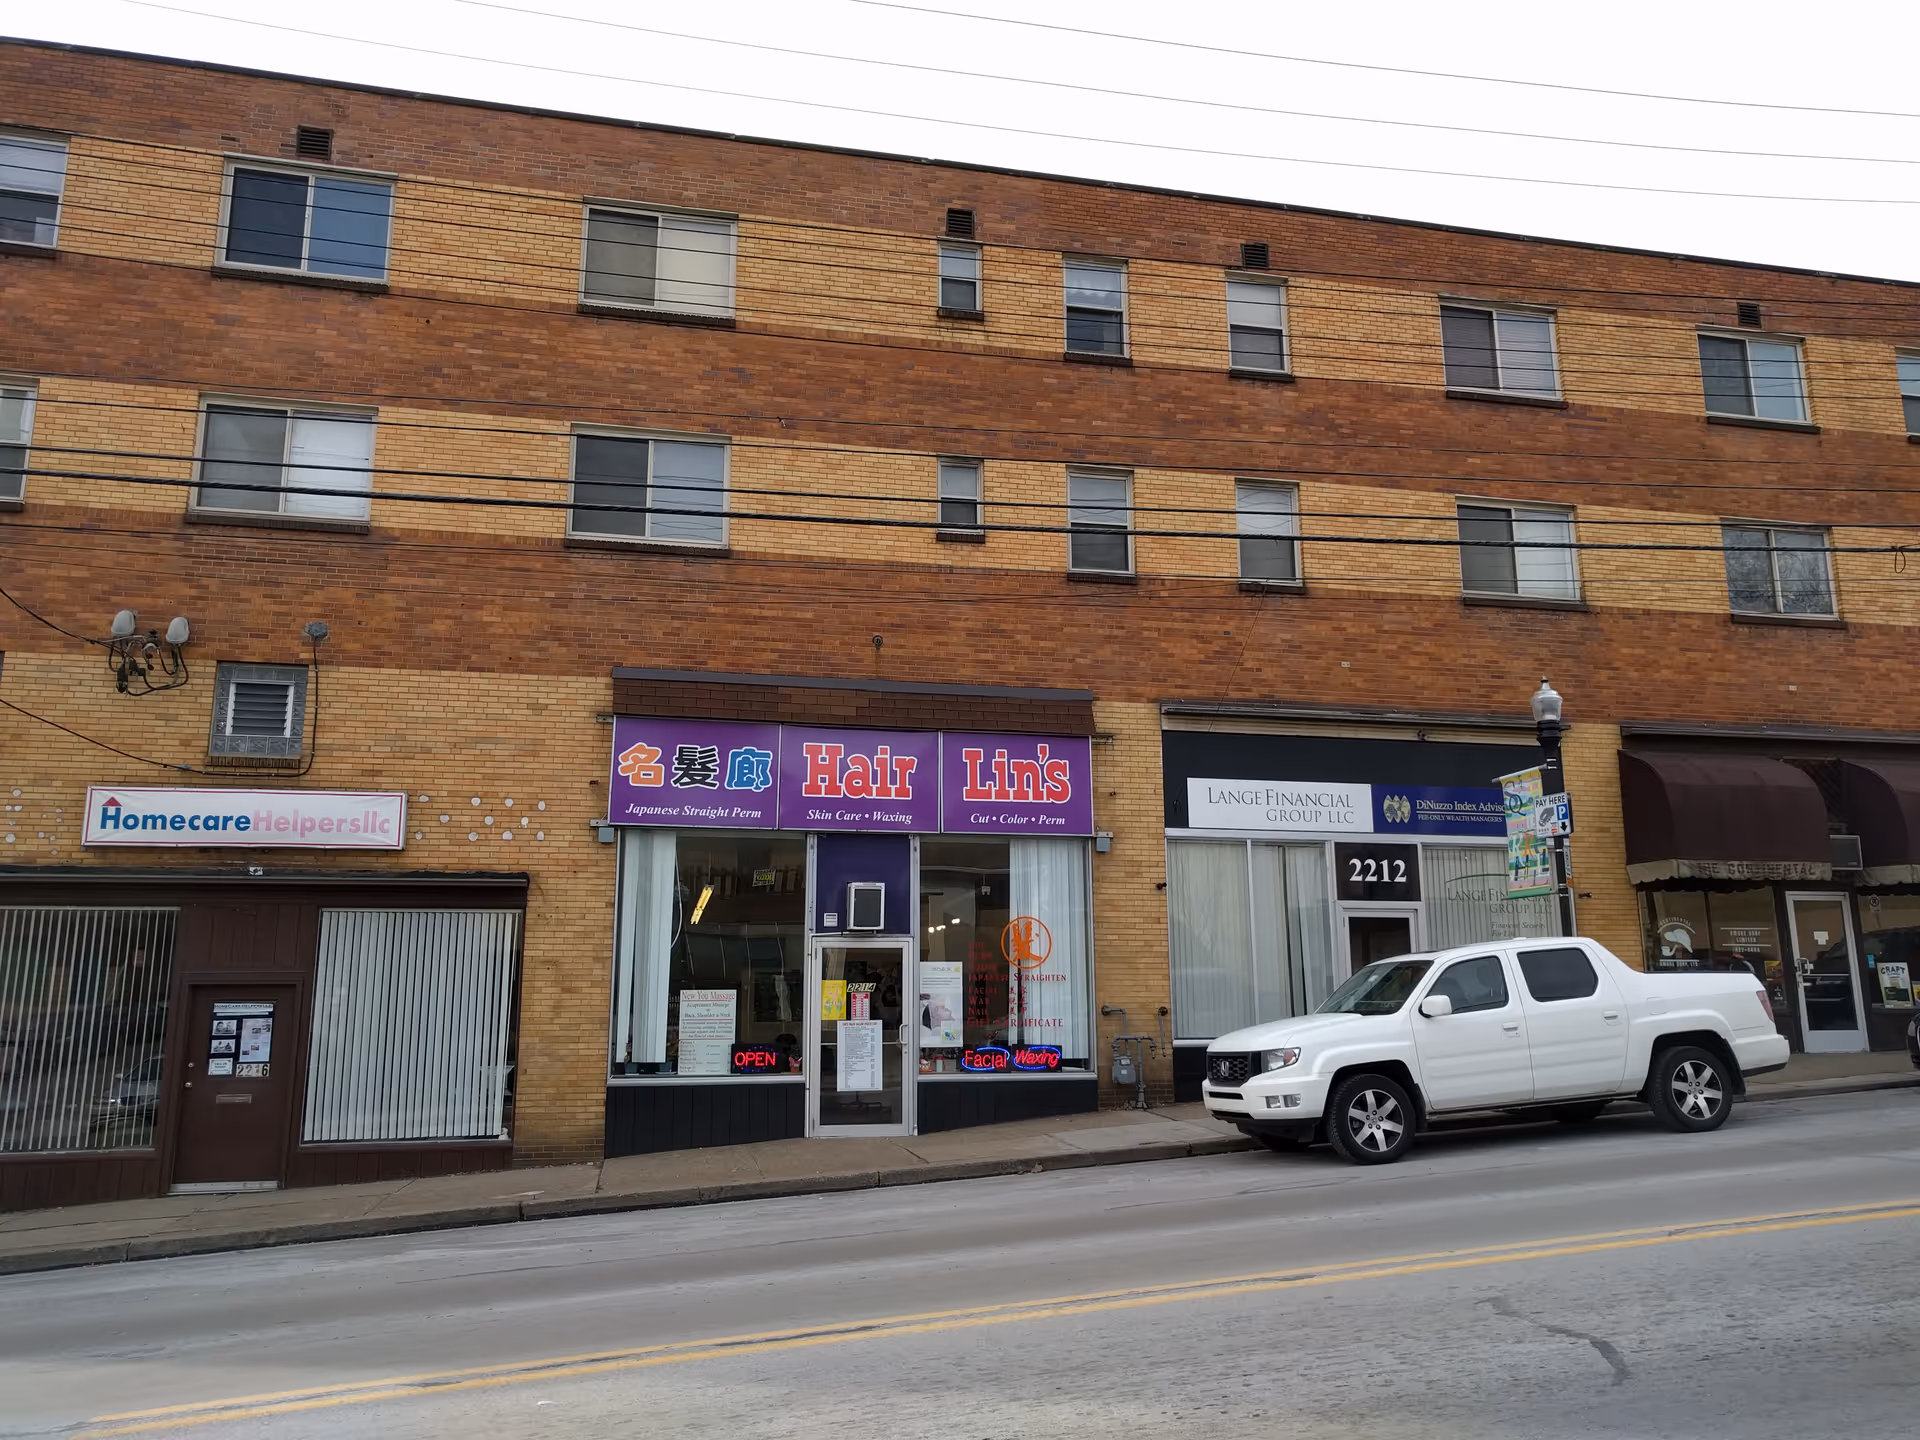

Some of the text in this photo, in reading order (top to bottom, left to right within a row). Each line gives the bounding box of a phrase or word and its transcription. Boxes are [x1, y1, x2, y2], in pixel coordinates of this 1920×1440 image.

[618, 742, 773, 792] 名髮廊
[802, 742, 918, 800] Hair
[963, 744, 1072, 804] Lin's
[1208, 787, 1353, 808] LANGE FINANCIAL
[1535, 795, 1566, 808] PAY HERE
[626, 803, 762, 819] Japanese Straight Perm
[1416, 800, 1453, 811] DiNuzzo
[1454, 801, 1477, 811] Index
[1558, 805, 1567, 819] P
[807, 809, 912, 824] Skin Care Waxing
[970, 813, 1066, 825] Cut Color Perm
[1266, 809, 1354, 824] GROUP LLC
[1349, 858, 1407, 882] 2212
[1013, 972, 1067, 982] STRAIGHTEN
[1880, 966, 1906, 975] CRAFT
[847, 983, 876, 993] 2214
[697, 991, 709, 1000] You
[710, 991, 736, 1002] Massage
[734, 1051, 776, 1066] OPEN
[964, 1050, 1008, 1068] Facial
[1015, 1049, 1059, 1068] Waxing
